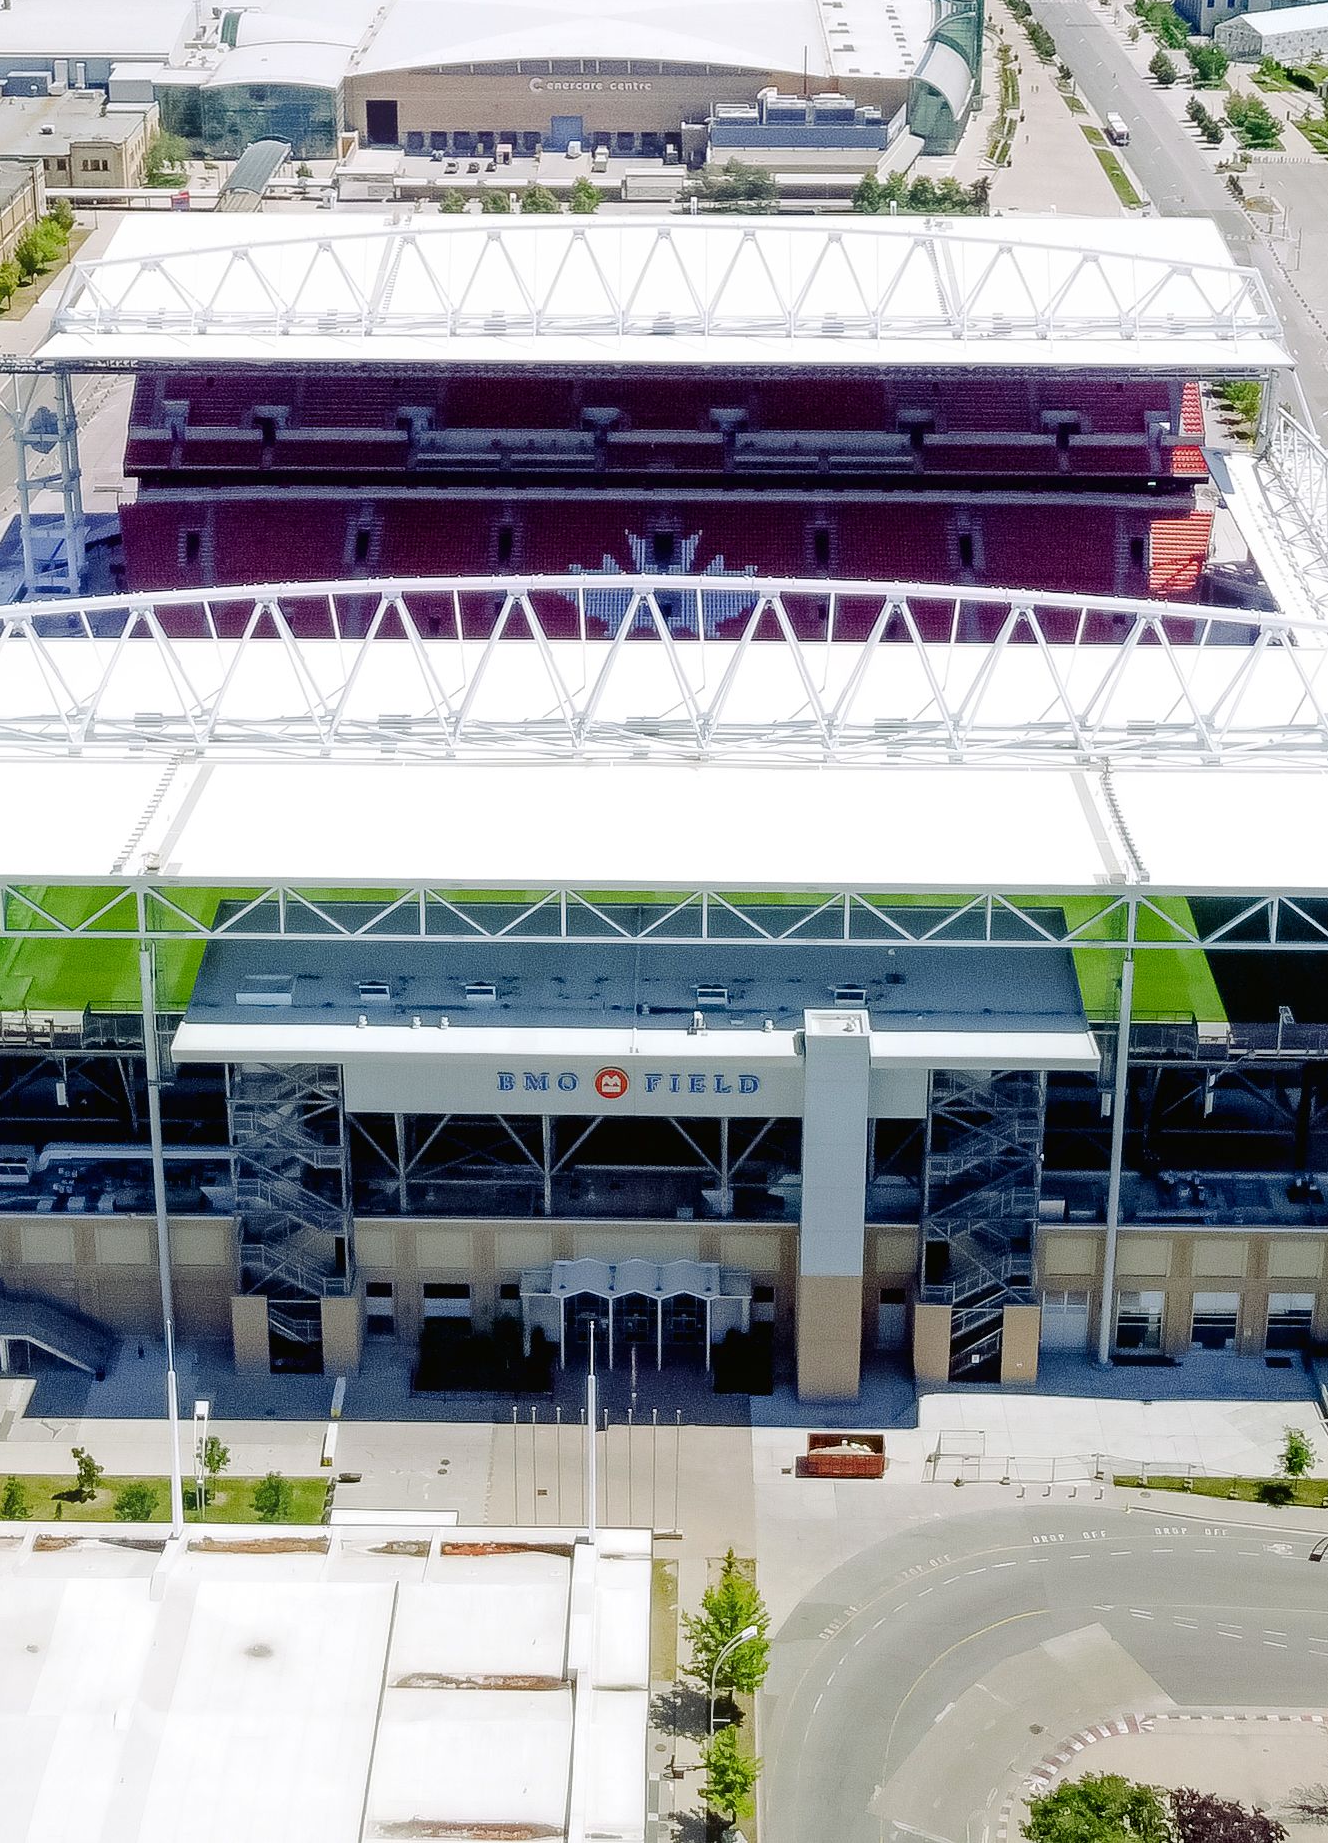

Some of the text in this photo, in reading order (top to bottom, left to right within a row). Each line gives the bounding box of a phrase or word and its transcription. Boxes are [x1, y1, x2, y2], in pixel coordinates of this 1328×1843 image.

[546, 81, 652, 91] enercare centre
[496, 1071, 760, 1094] BMO FIELD
[1032, 1529, 1108, 1544] DROP OFF
[1153, 1527, 1229, 1537] DROP OFF
